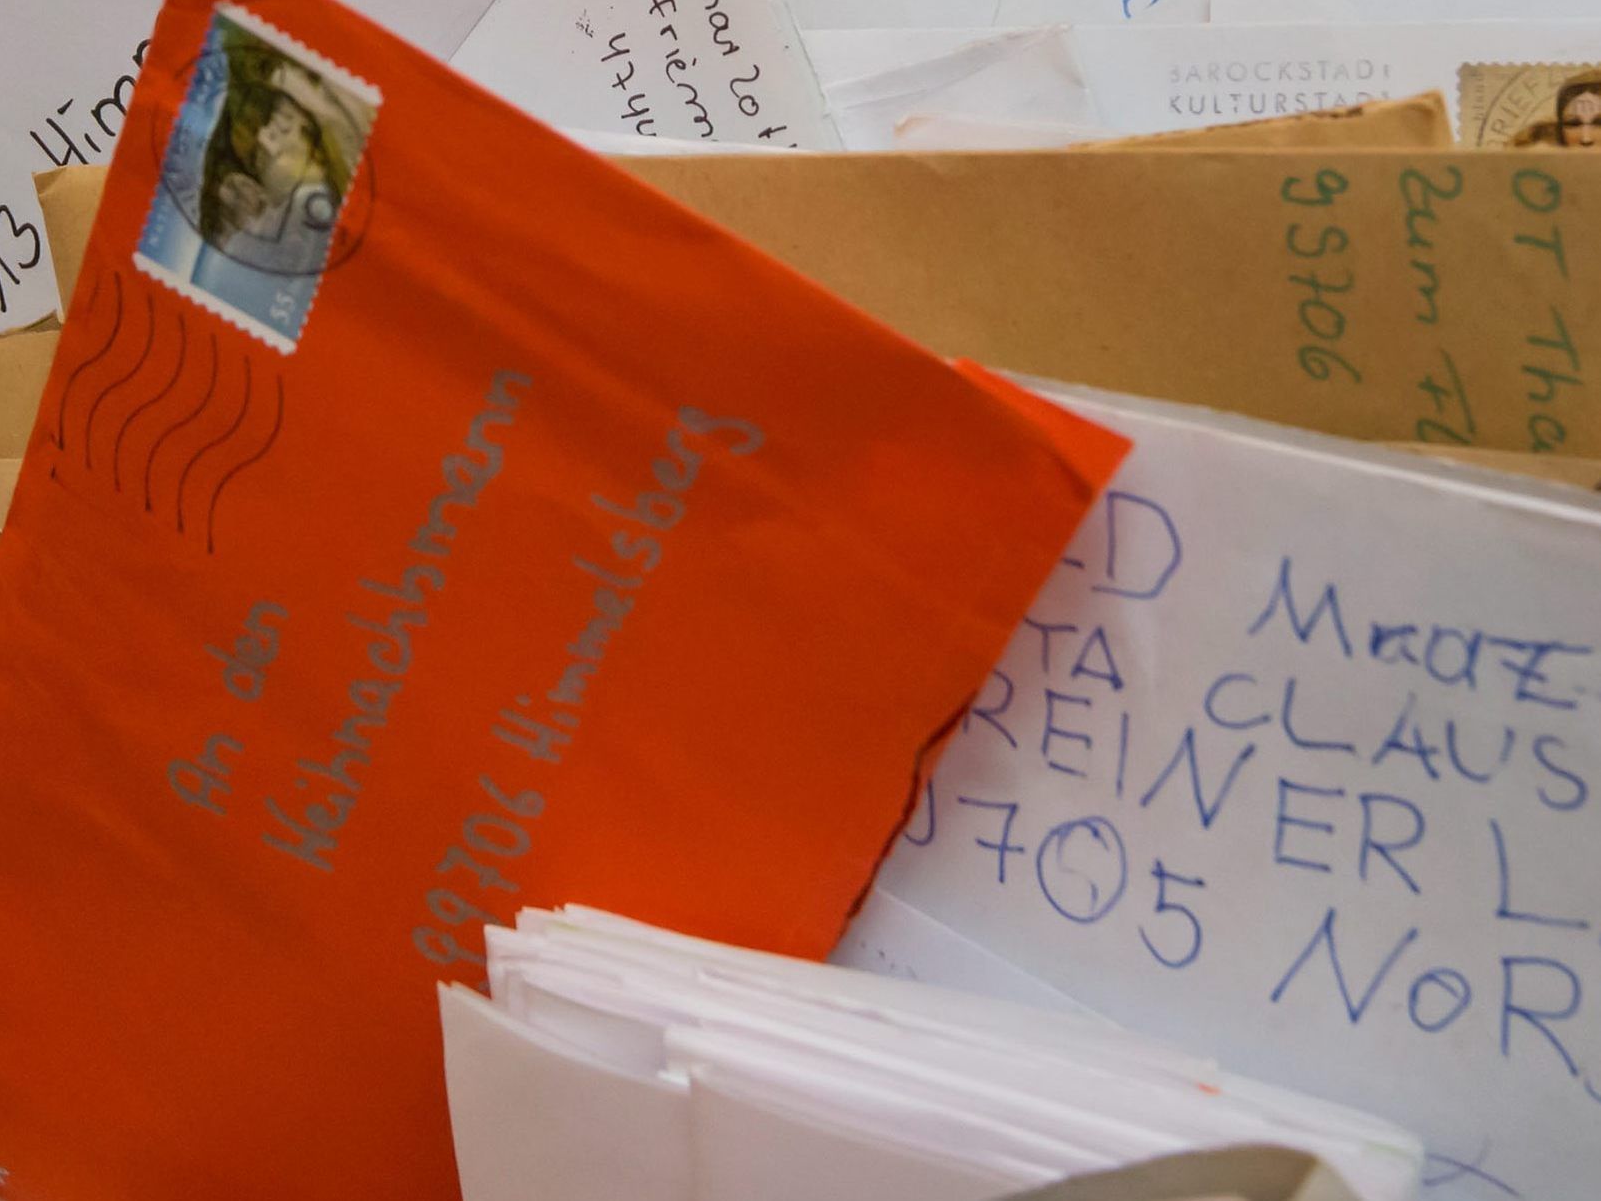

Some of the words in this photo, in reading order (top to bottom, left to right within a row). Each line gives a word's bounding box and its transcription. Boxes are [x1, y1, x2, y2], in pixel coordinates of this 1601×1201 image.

[204, 598, 291, 703] den
[411, 772, 547, 991] 99706
[489, 404, 766, 764] Himmelsberg
[165, 730, 246, 818] An
[1203, 671, 1590, 812] CLAUS
